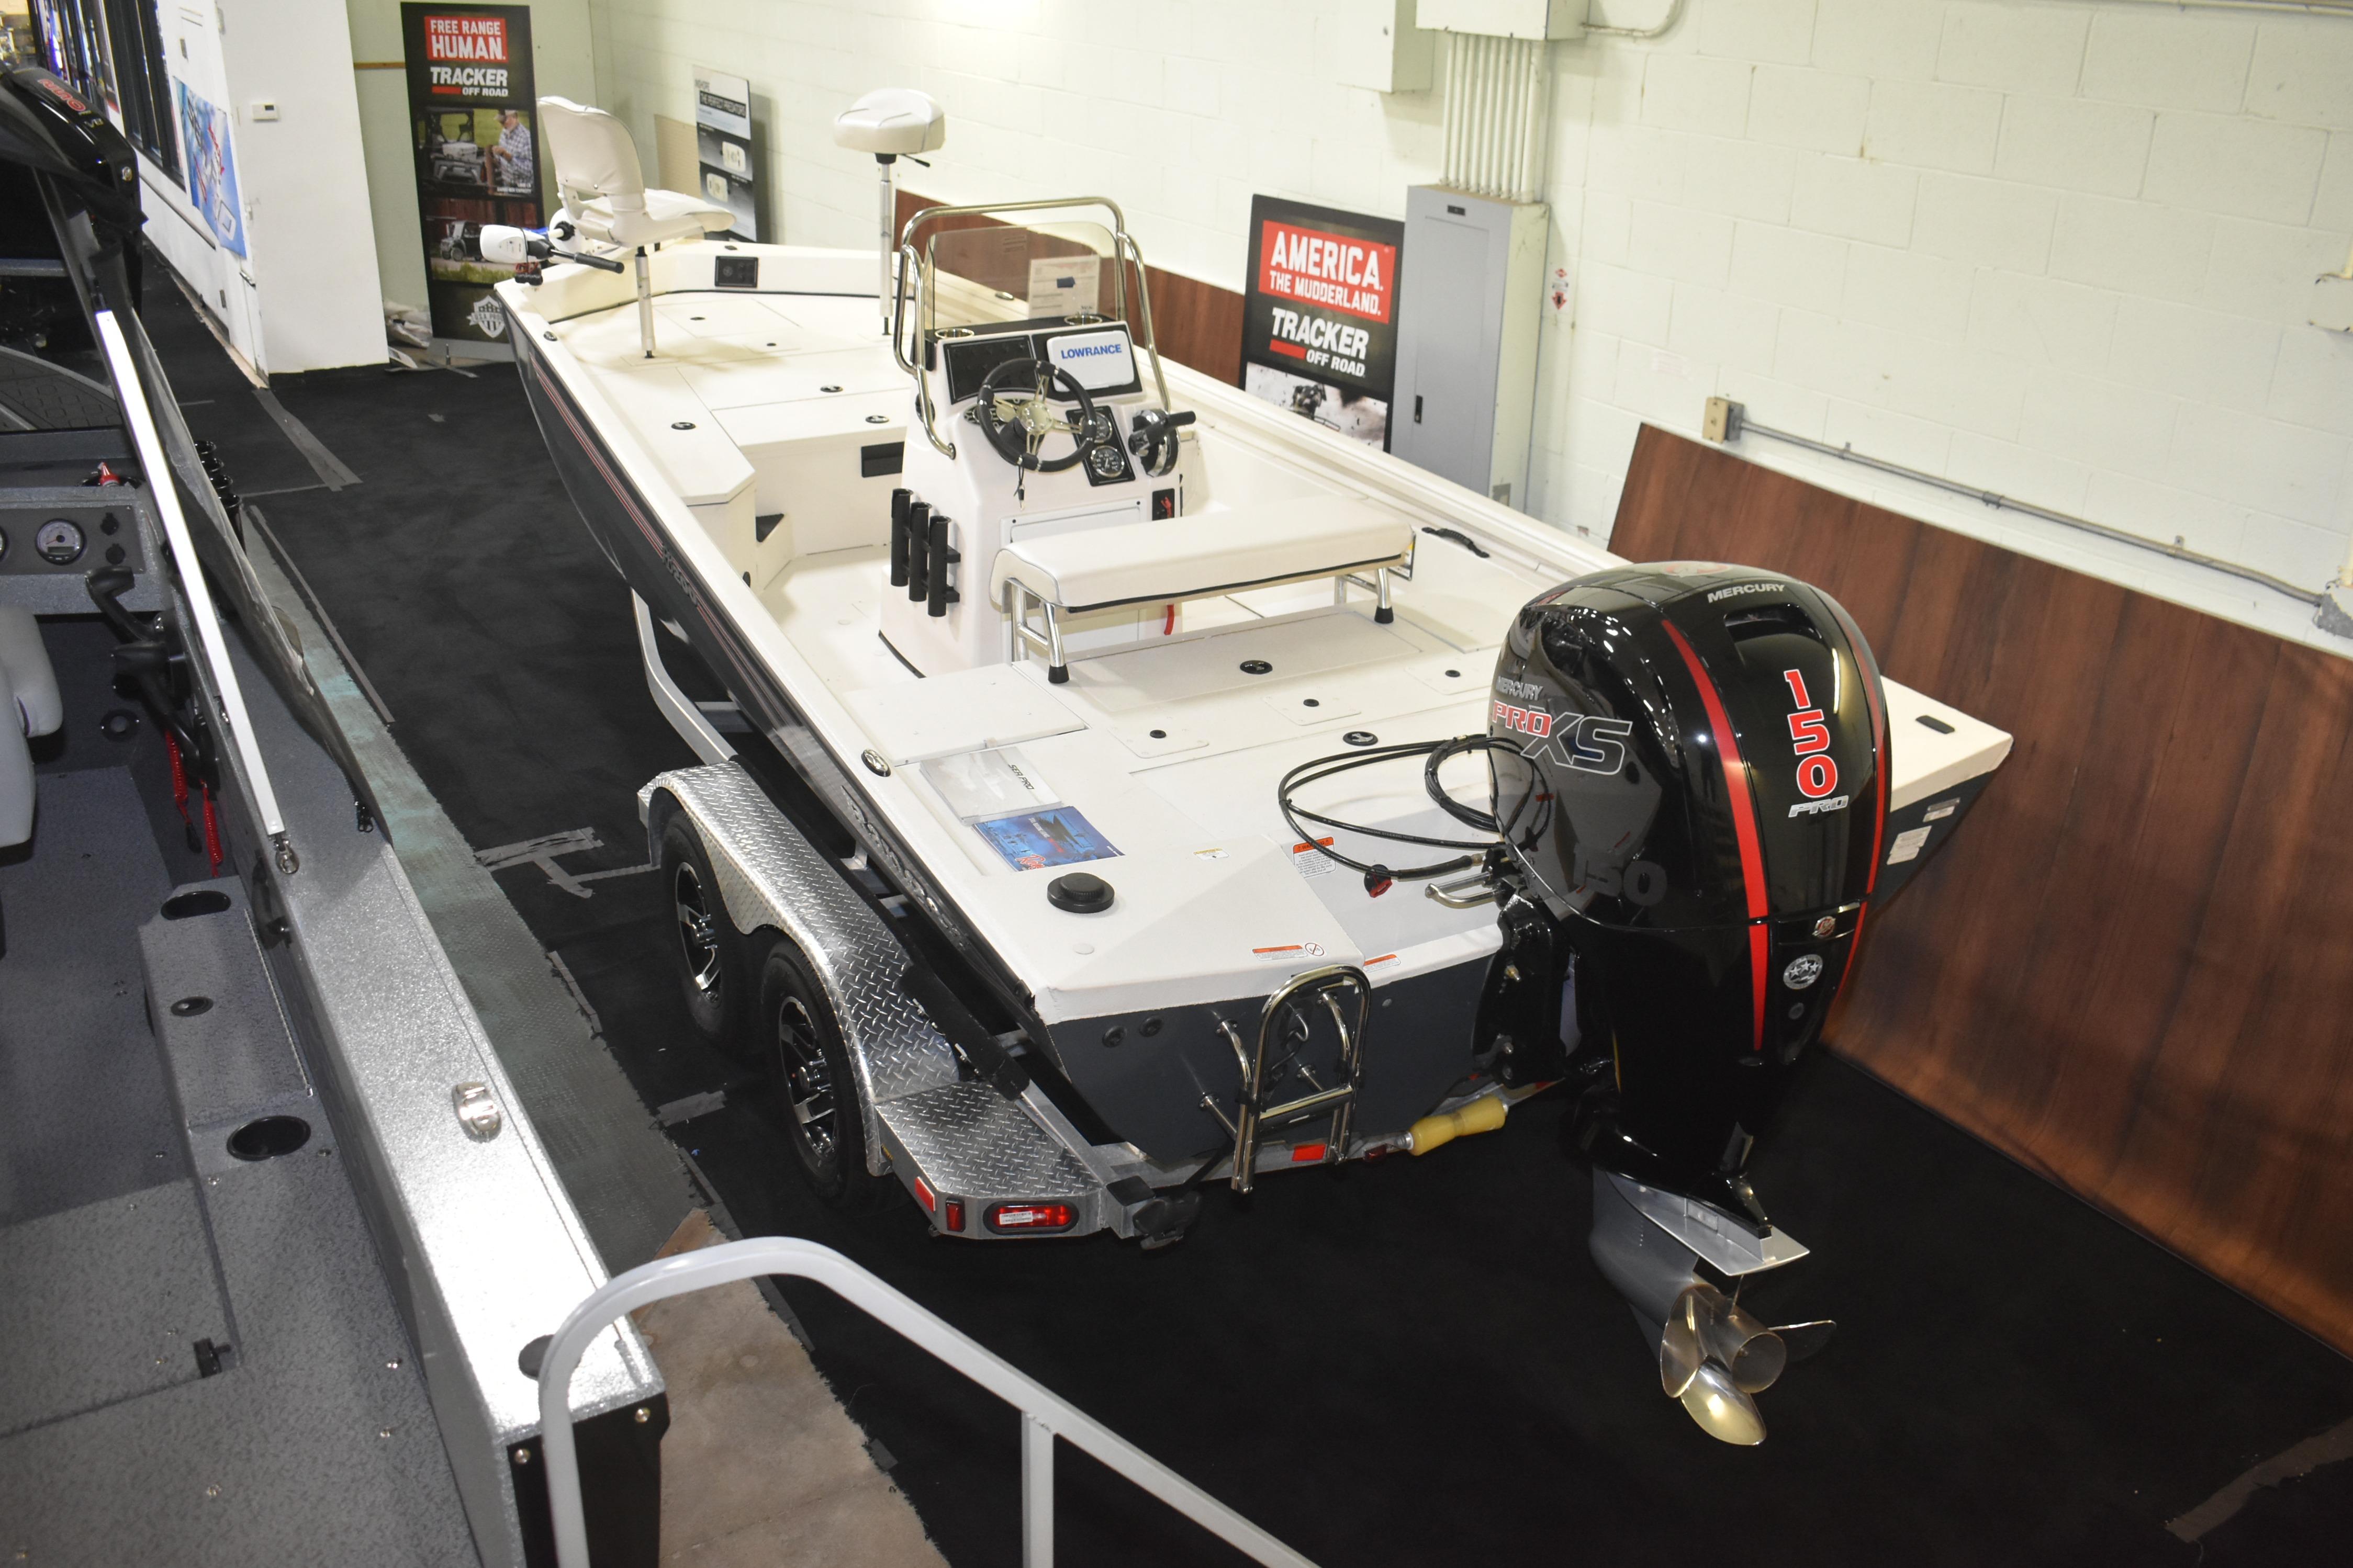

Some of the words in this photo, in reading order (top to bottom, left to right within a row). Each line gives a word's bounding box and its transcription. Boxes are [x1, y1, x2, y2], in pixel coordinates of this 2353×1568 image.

[430, 20, 458, 33] FREE
[462, 21, 501, 35] RANGE
[431, 35, 506, 60] HUMAN.
[430, 66, 508, 86] TRACKER
[462, 87, 480, 96] OFF
[482, 88, 508, 96] ROAD
[1270, 231, 1383, 291] AMERICA.
[1270, 270, 1292, 293] THE
[1294, 276, 1381, 316] MUDDERLAND.
[1272, 307, 1369, 359] TRACKER
[1061, 344, 1122, 359] LOWRANCE
[1306, 349, 1329, 367] OFF
[1331, 356, 1365, 378] ROAD
[1707, 583, 1785, 603] MERCURY
[1496, 676, 1543, 701] MERCURY
[1493, 700, 1552, 738] PRO
[1520, 712, 1633, 775] XS
[1784, 669, 1837, 798] 150
[1008, 764, 1023, 776] SEA
[1018, 777, 1034, 789] PRO
[1788, 795, 1849, 818] PRO
